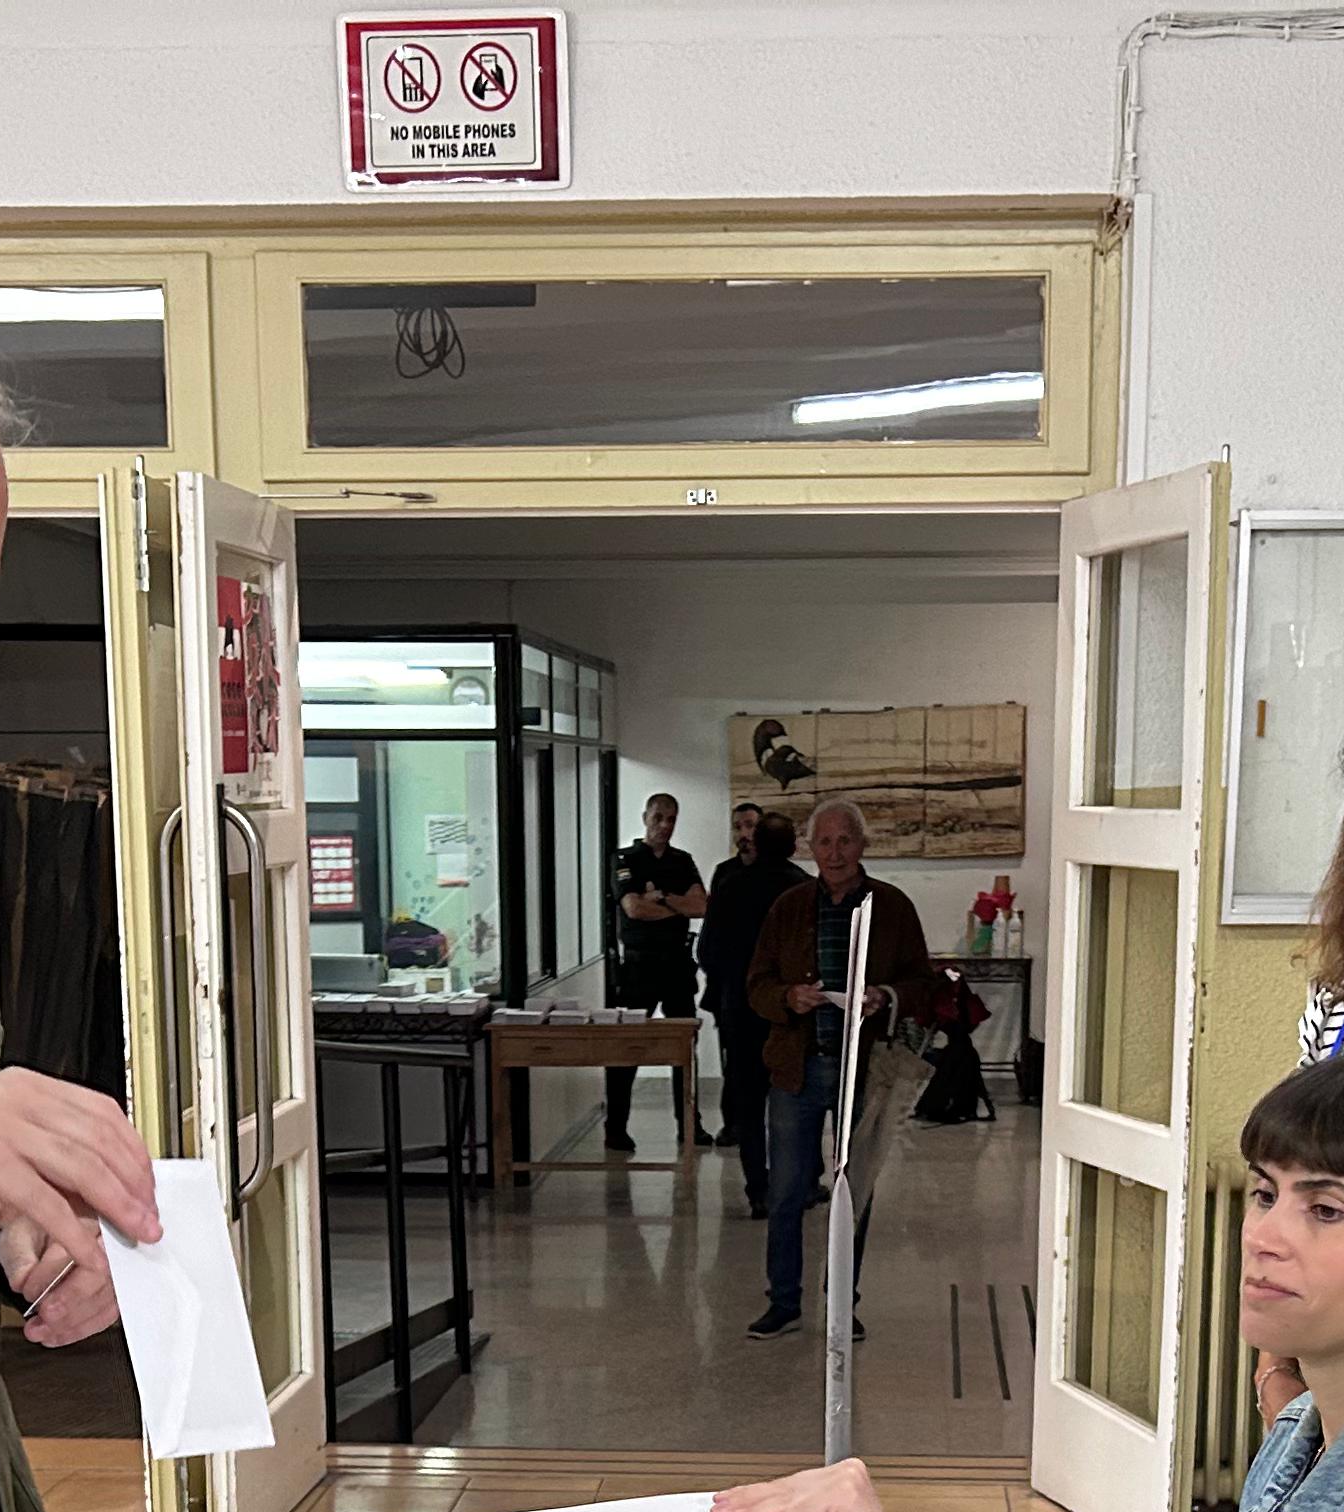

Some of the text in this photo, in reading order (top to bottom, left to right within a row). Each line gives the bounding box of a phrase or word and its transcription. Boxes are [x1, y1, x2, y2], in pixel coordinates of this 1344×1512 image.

[390, 124, 516, 141] NO MOBILE PHONES
[411, 142, 496, 159] IN THIS AREA
